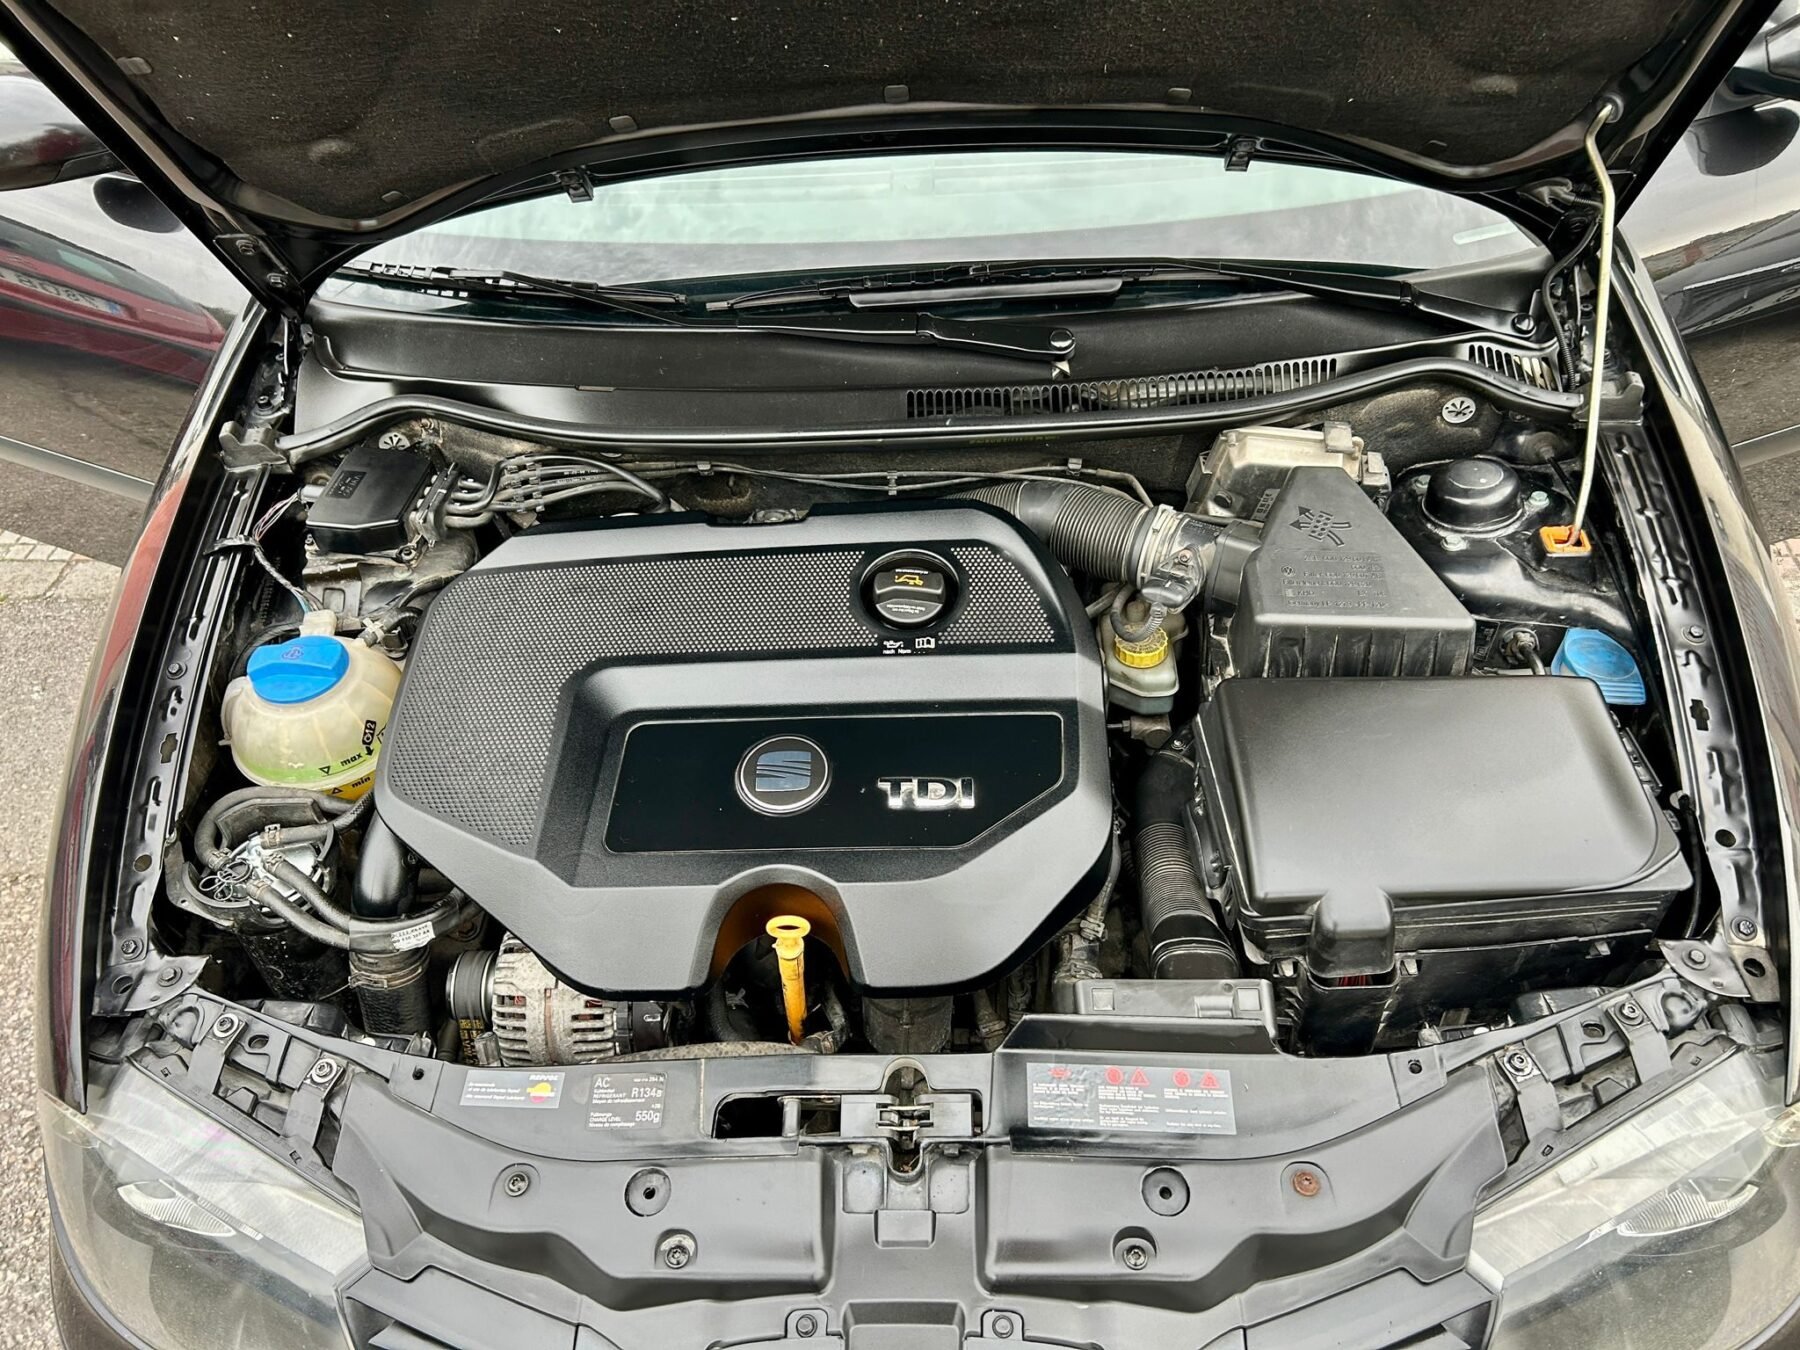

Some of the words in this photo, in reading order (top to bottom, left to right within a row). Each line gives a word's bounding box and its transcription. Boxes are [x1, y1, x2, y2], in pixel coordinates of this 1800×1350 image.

[340, 752, 363, 767] max
[352, 776, 371, 788] min
[878, 776, 975, 809] TDI
[594, 1077, 611, 1088] AC
[635, 1110, 660, 1124] 550g
